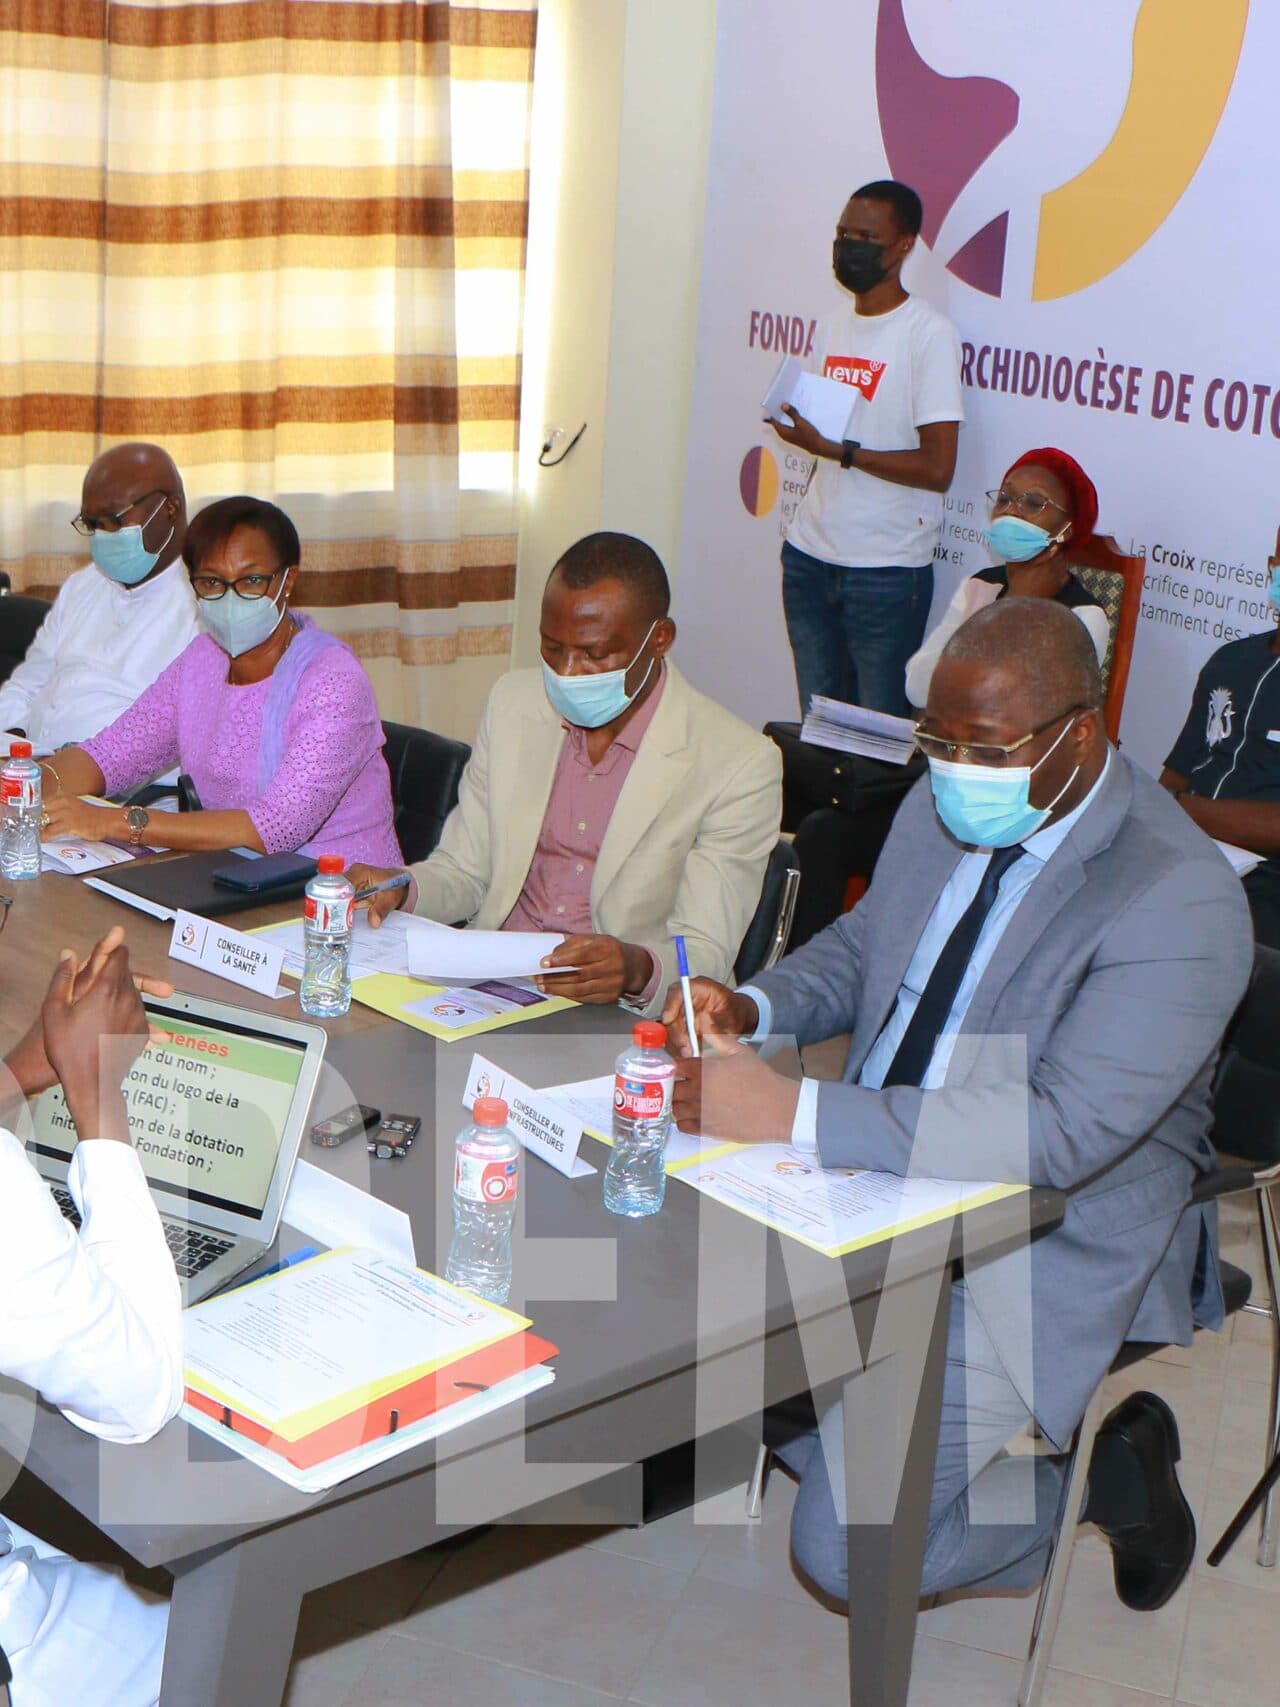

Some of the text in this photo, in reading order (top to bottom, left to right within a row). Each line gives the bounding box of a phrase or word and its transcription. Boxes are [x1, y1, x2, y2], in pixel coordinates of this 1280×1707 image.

[1150, 370, 1195, 424] DE
[957, 500, 974, 517] un
[952, 550, 965, 566] et
[1129, 537, 1146, 559] La
[1152, 544, 1196, 572] Croix
[1193, 586, 1234, 610] pour
[216, 937, 261, 962] CONSEILLER
[261, 952, 269, 967] À
[222, 954, 257, 976] LA SANTÉ
[155, 1049, 173, 1066] du
[176, 1057, 208, 1075] nom
[151, 1073, 169, 1090] du
[172, 1077, 202, 1100] logo
[205, 1088, 223, 1105] de
[226, 1092, 239, 1109] la
[512, 1098, 566, 1139] CONSEILLER AUX
[135, 1135, 205, 1169] Fondation
[147, 1118, 166, 1135] de
[168, 1122, 181, 1140] la
[184, 1128, 245, 1159] dotation
